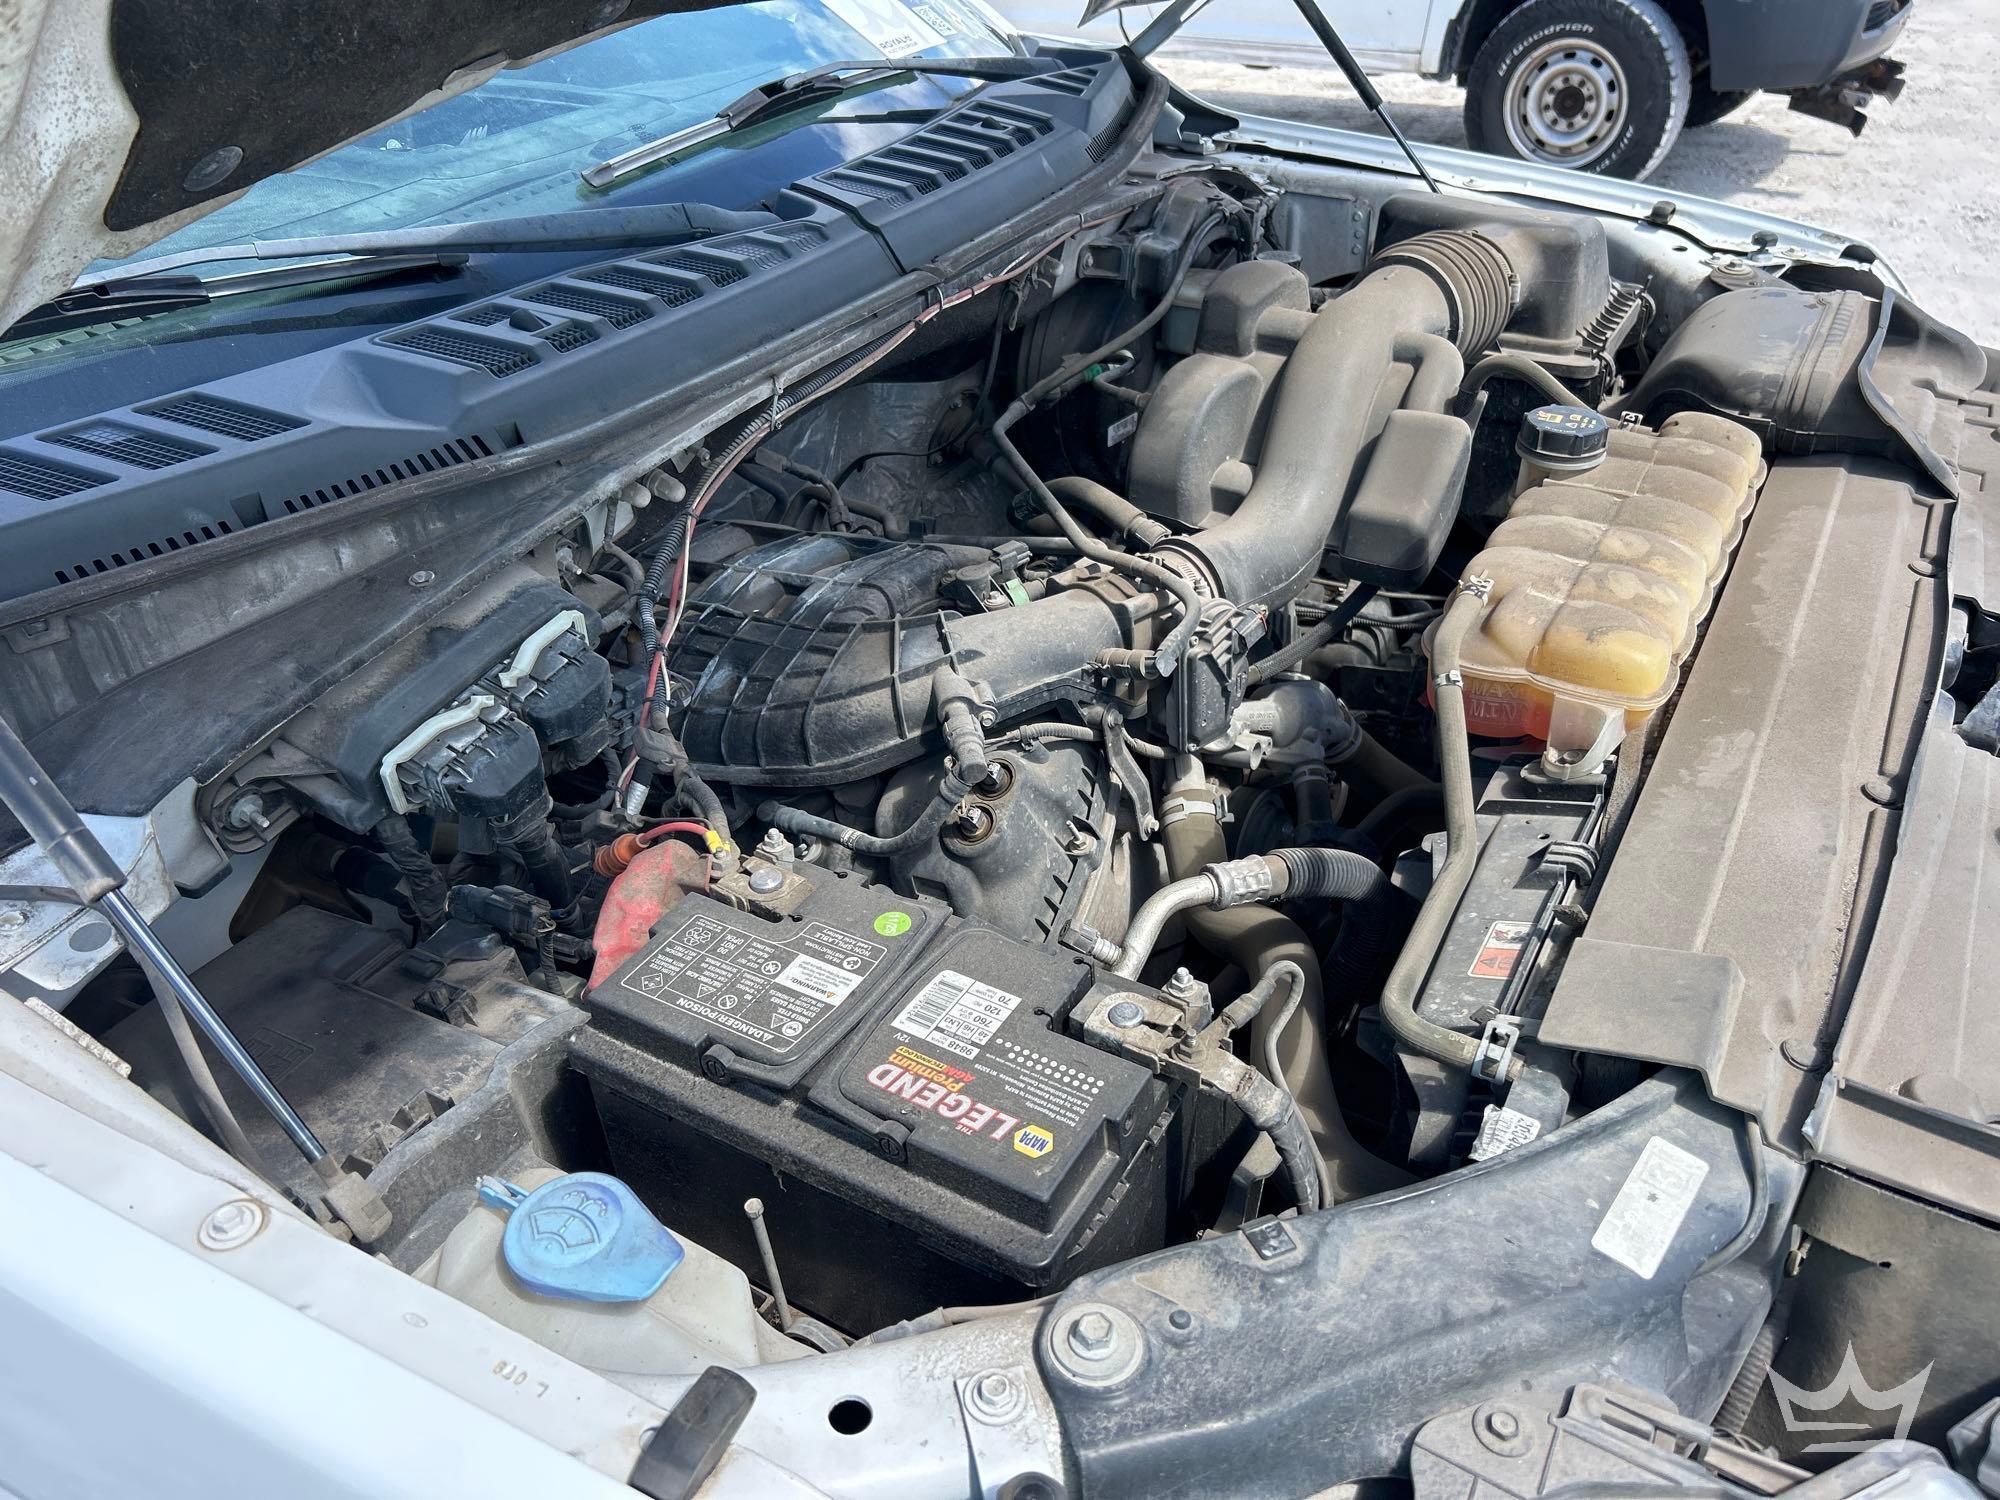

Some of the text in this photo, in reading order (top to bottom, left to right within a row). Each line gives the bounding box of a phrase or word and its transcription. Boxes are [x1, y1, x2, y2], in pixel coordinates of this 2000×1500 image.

[1472, 682, 1516, 697] MAX
[1470, 699, 1517, 720] MIN
[720, 941, 737, 949] NOT
[813, 933, 872, 956] NON-SPILLABLE
[998, 995, 1011, 1005] 70
[984, 1004, 1002, 1016] 120
[677, 998, 764, 1038] DANGER/POISON
[944, 1017, 960, 1027] LN3
[973, 1015, 993, 1027] 760
[962, 1024, 975, 1033] H6
[893, 1032, 912, 1043] 12V
[948, 1040, 974, 1056] 9848
[898, 1046, 976, 1083] AGM TECHNOLOGY
[888, 1053, 964, 1092] Premium
[867, 1063, 1018, 1141] LEGEND
[955, 1123, 973, 1135] THE
[1019, 1131, 1048, 1152] NAPA
